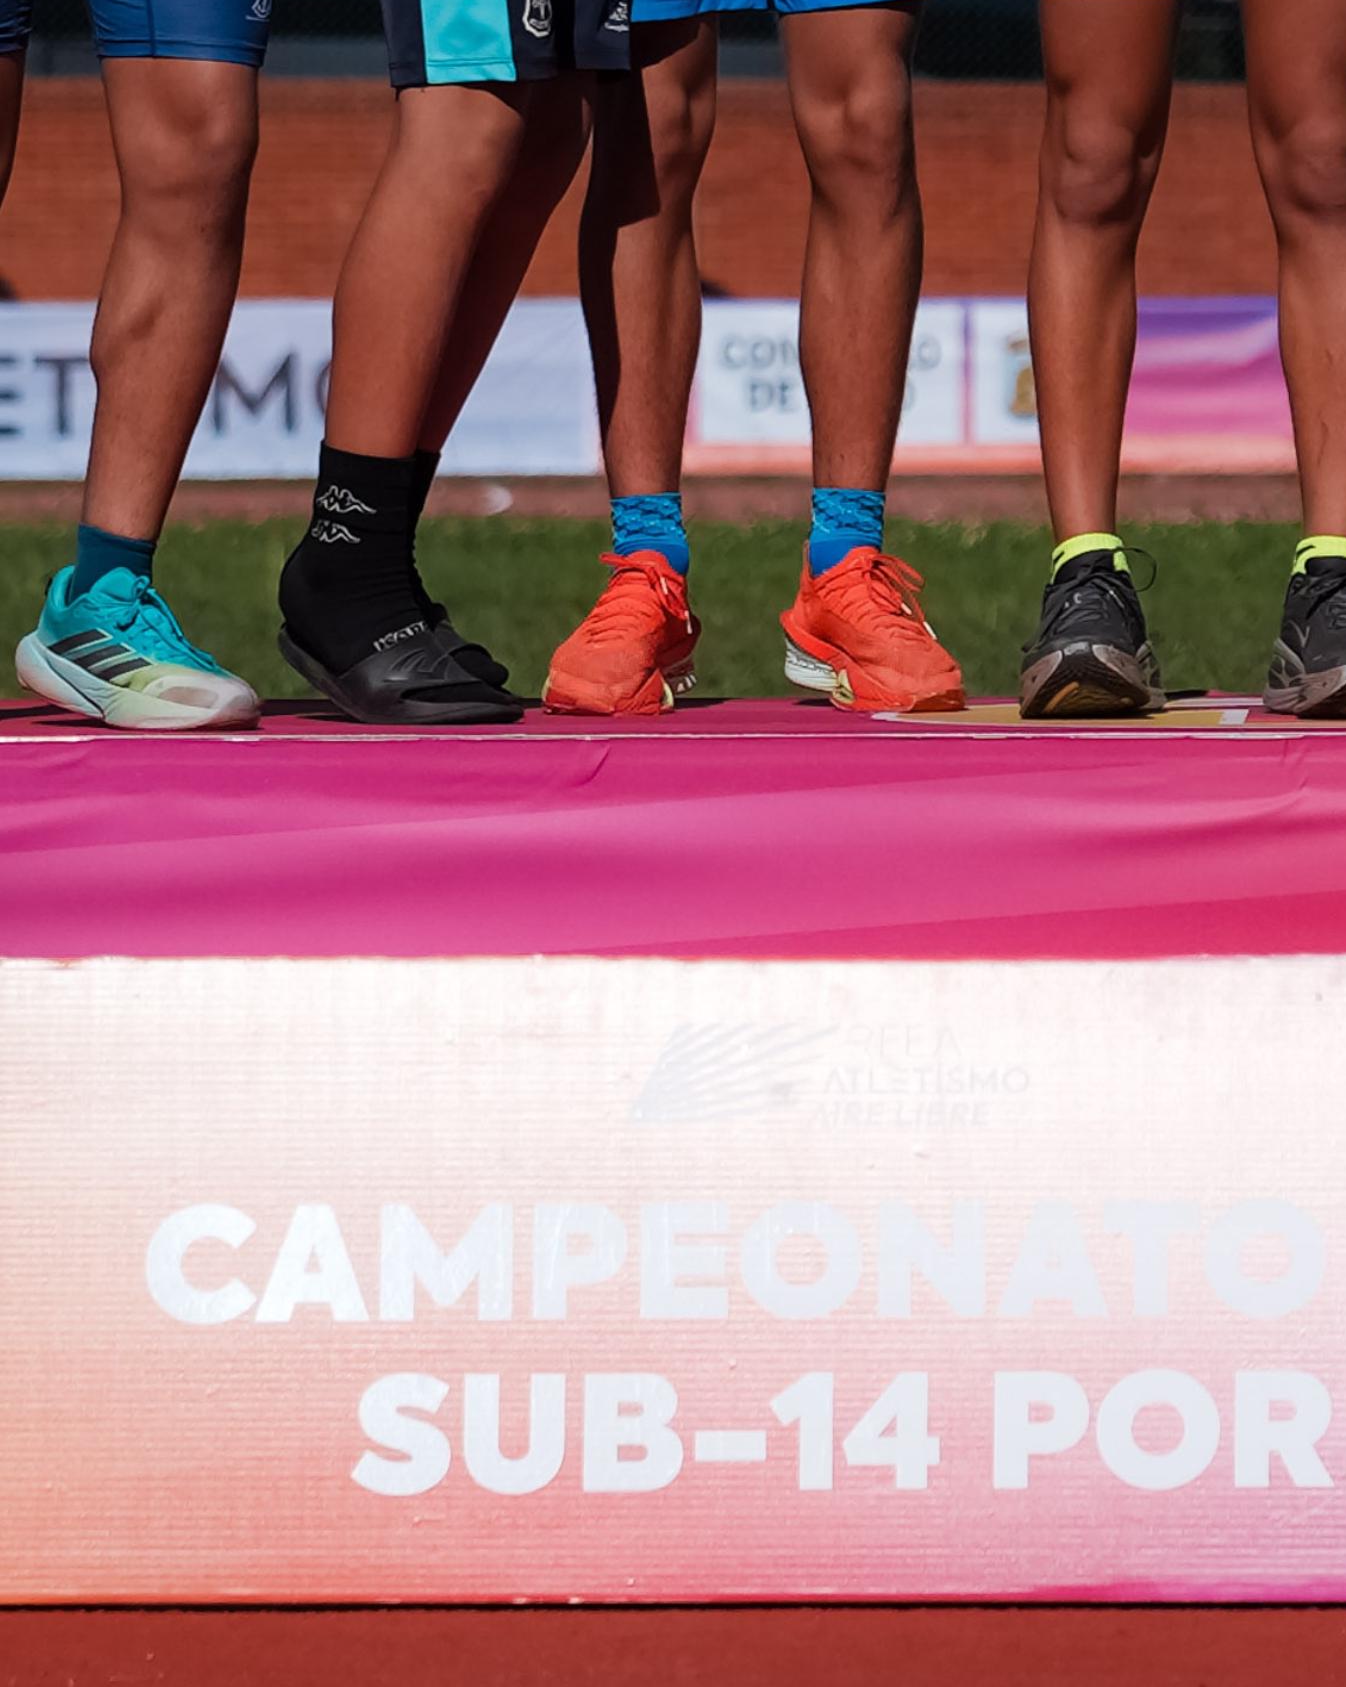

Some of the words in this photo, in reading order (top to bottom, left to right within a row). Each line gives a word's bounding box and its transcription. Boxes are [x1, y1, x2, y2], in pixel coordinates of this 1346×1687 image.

[809, 1101, 886, 1130] AIRE
[894, 1101, 991, 1130] LIBRE
[822, 1065, 1031, 1095] ATLETISMO
[145, 1197, 1325, 1323] CAMPEONATO
[350, 1368, 940, 1496] SUB-14
[991, 1367, 1334, 1492] POR
